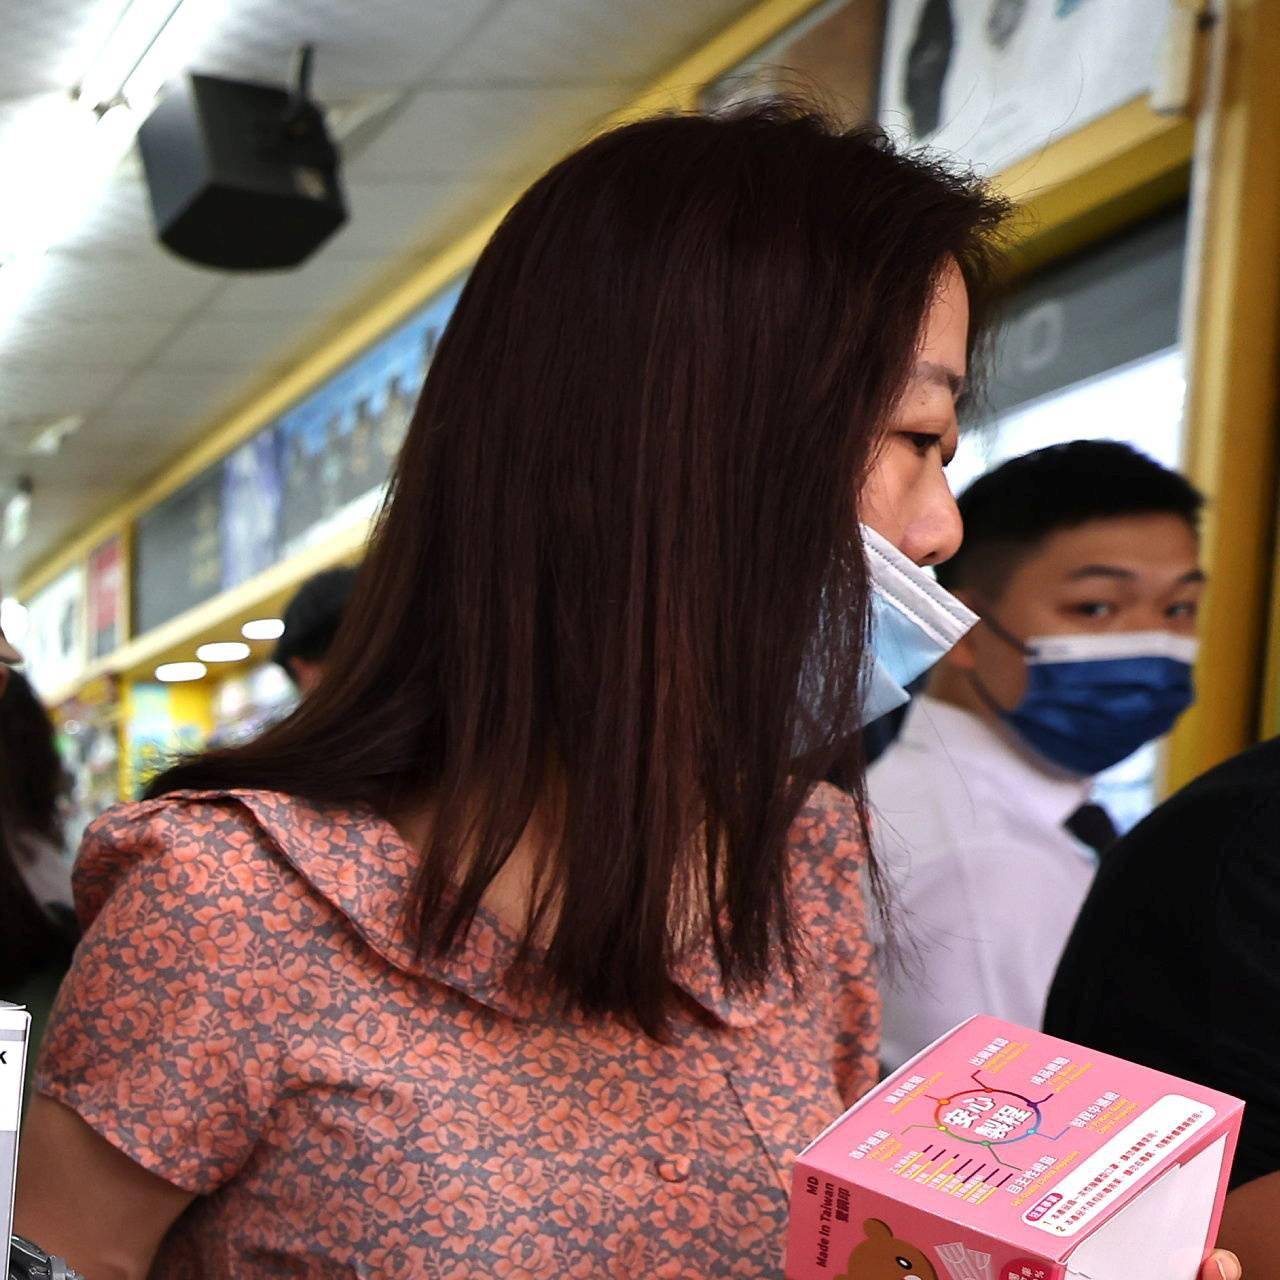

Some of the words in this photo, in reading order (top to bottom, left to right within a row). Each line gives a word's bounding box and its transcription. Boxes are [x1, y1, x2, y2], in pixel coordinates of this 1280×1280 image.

[942, 1096, 997, 1130] 安心
[972, 1104, 1035, 1140] 製程
[806, 1175, 820, 1196] MD
[819, 1182, 835, 1222] Taiwan
[815, 1241, 828, 1268] Made
